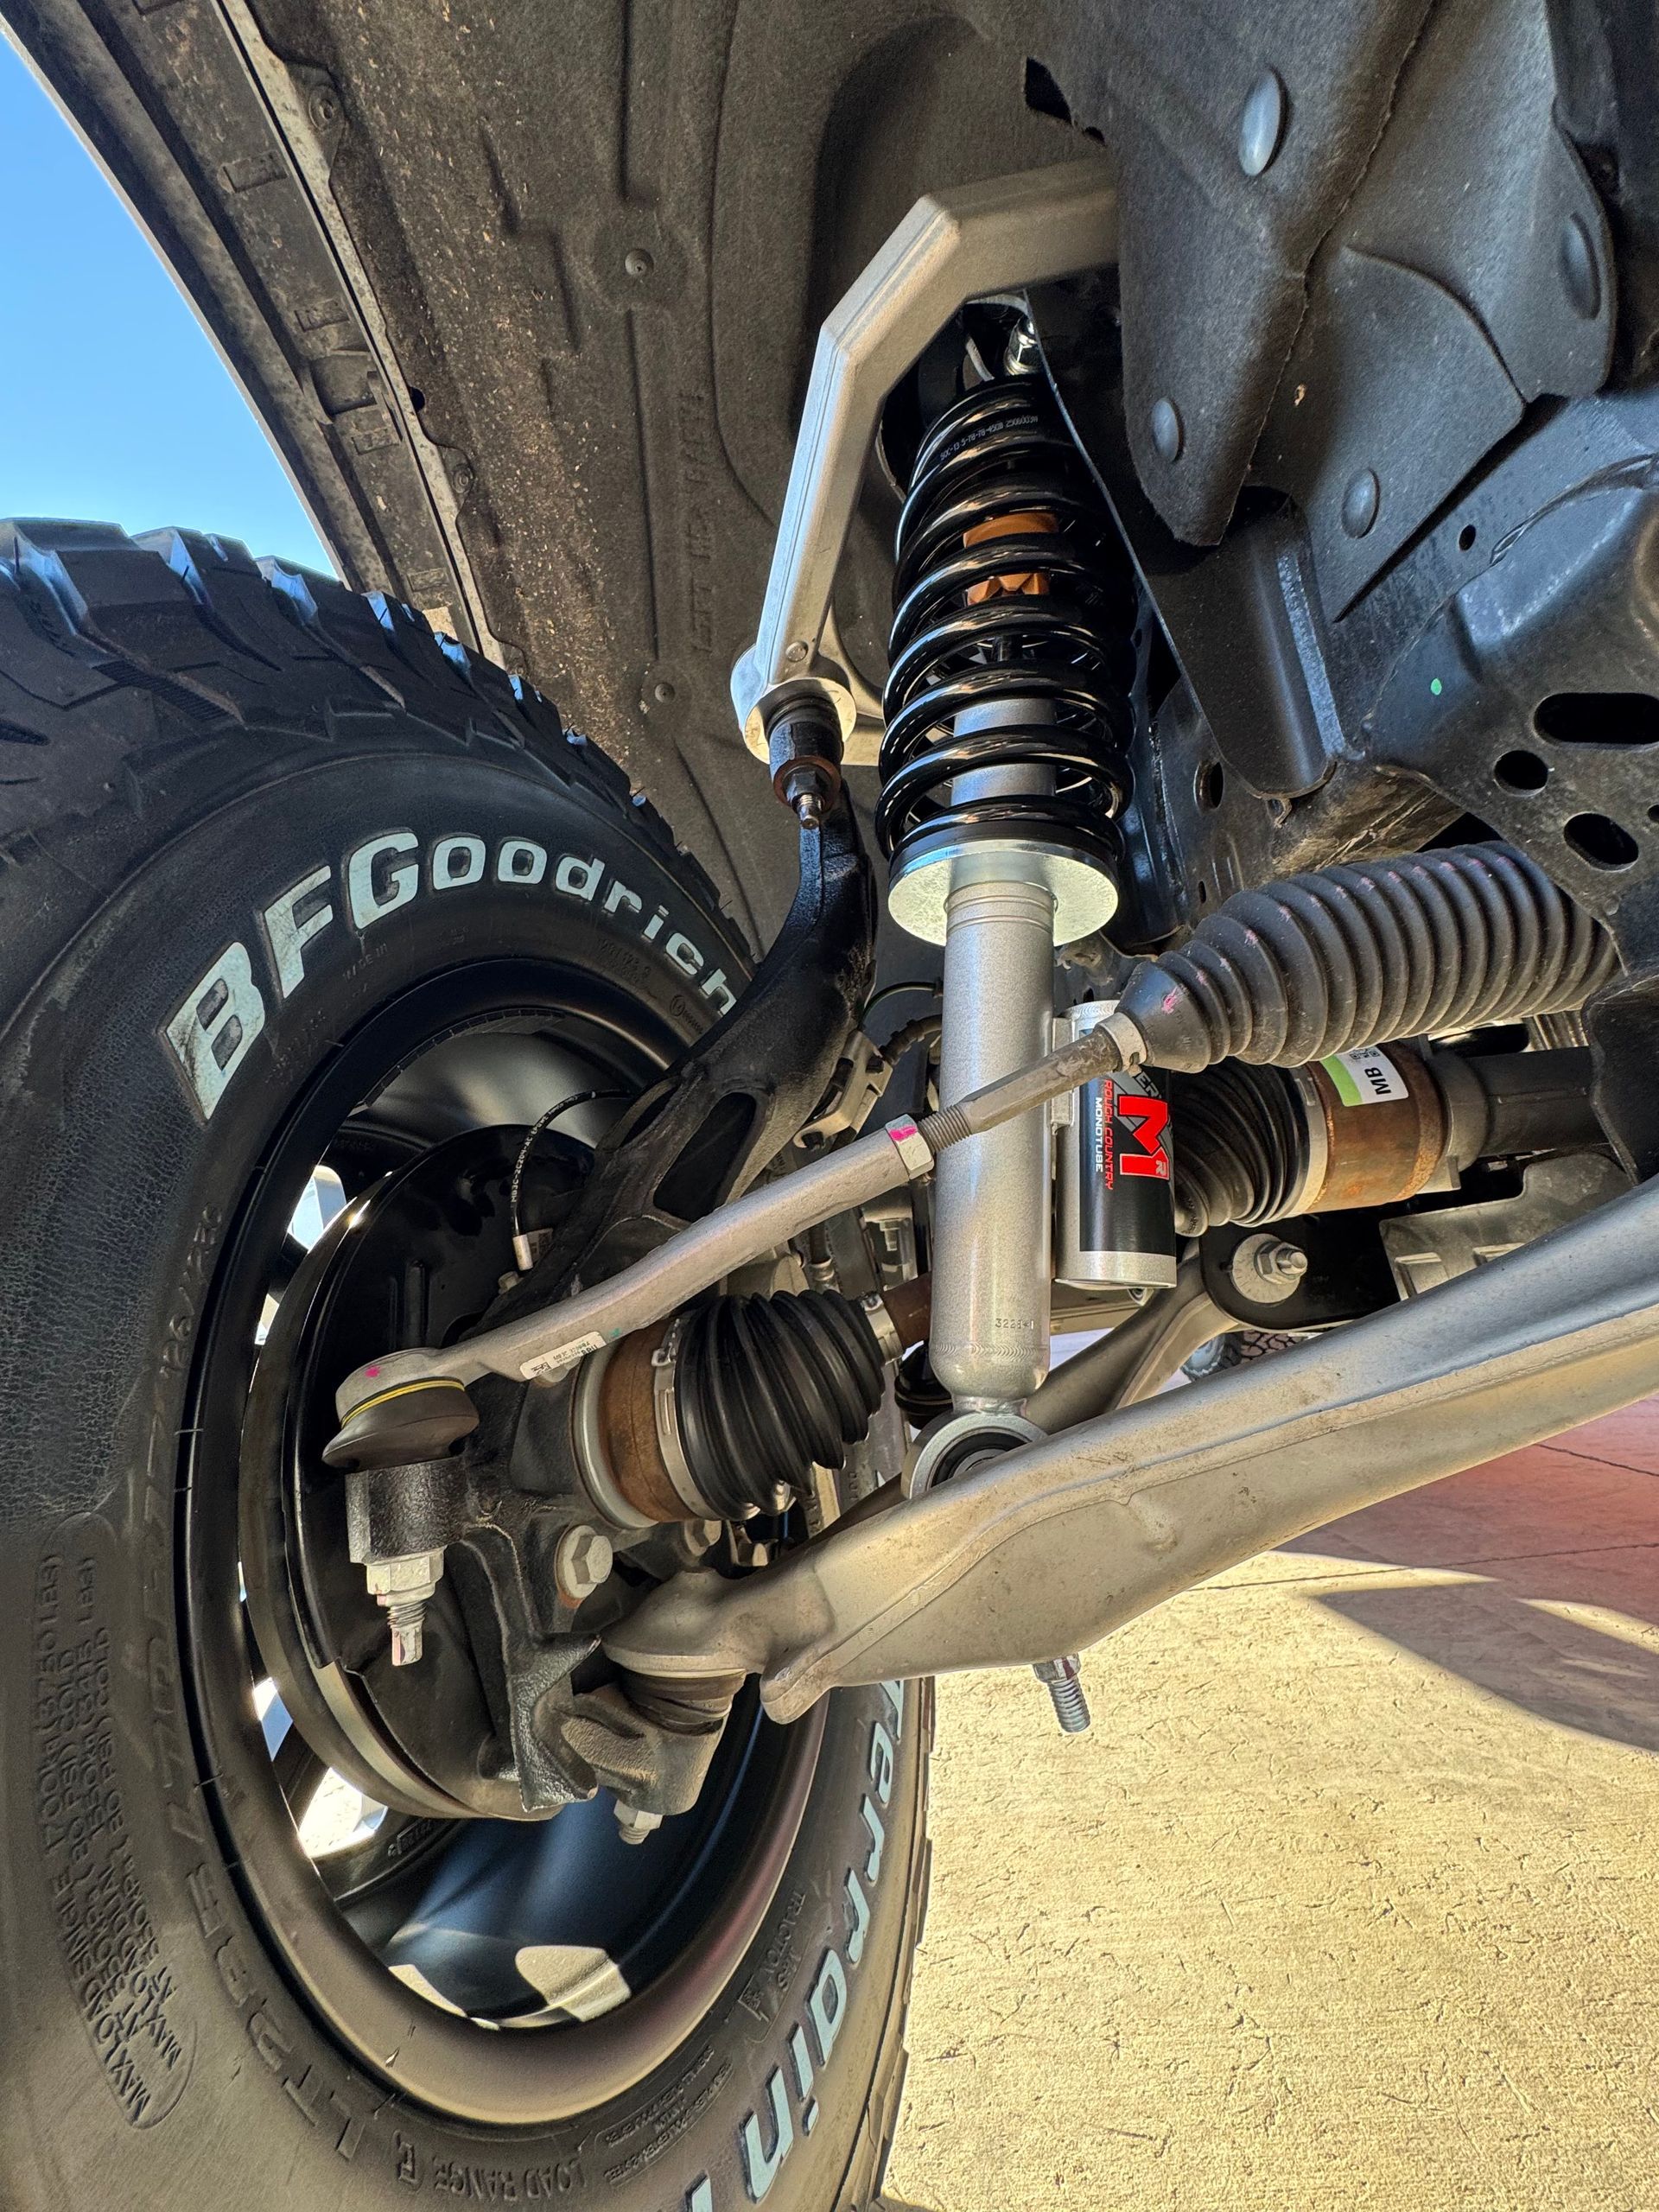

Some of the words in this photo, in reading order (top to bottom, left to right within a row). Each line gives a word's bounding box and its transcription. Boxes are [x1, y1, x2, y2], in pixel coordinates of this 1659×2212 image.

[167, 832, 738, 1120] BFGoodrich
[1104, 1079, 1114, 1124] ROUGH
[1364, 1066, 1392, 1095] MB
[1095, 1096, 1103, 1173] MONOTUBE
[1104, 1127, 1114, 1190] COUNTRY
[435, 2161, 518, 2202] RANGE
[524, 2159, 587, 2202] LOAD
